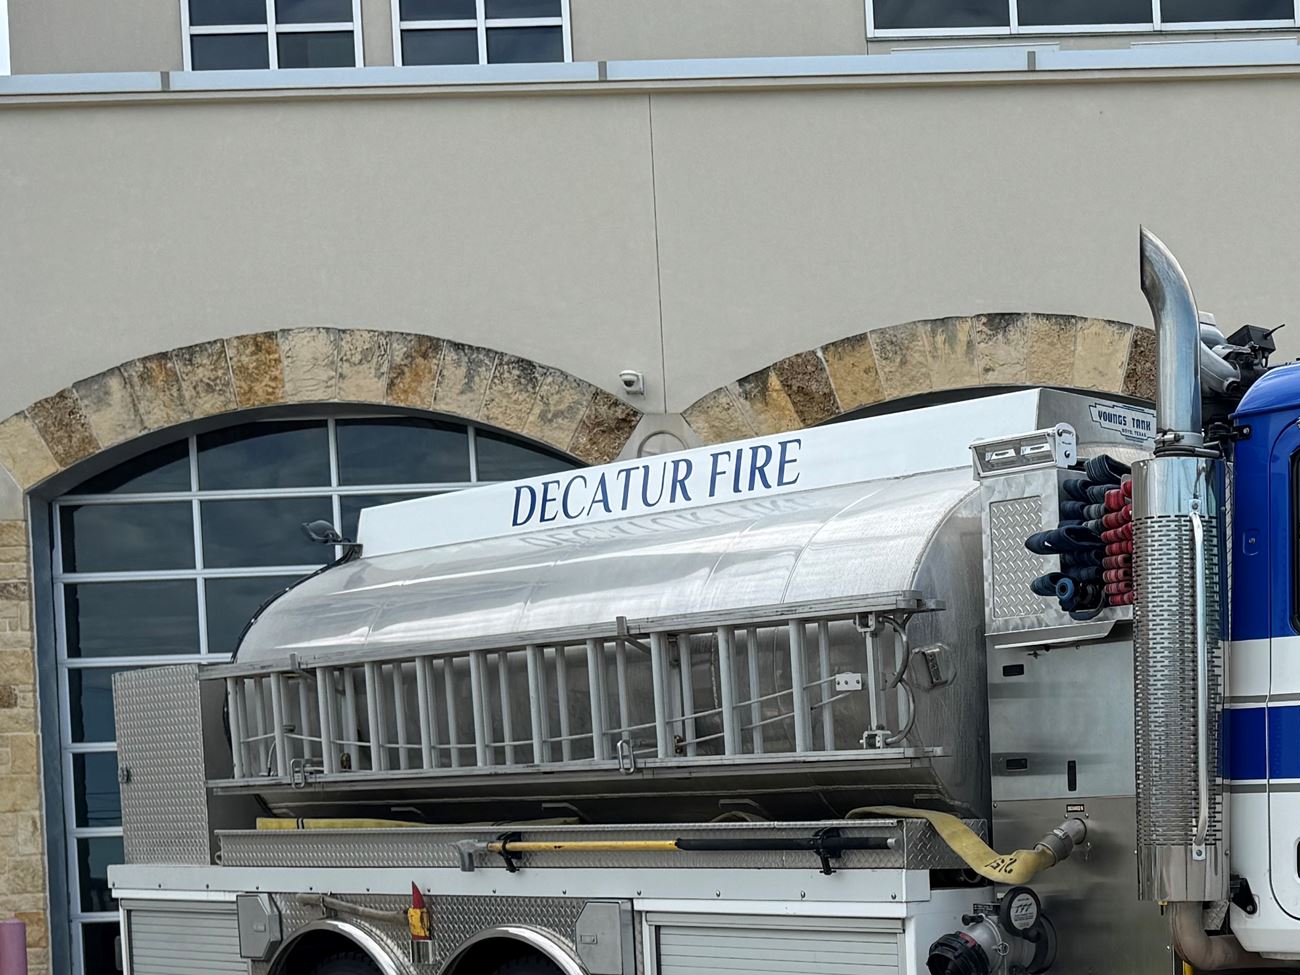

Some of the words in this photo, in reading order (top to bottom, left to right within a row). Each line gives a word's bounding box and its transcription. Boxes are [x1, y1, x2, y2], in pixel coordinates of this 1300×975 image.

[1098, 410, 1127, 426] YOUNGS
[1132, 417, 1151, 431] TANK
[512, 458, 693, 527] DECATUR
[708, 438, 801, 498] FIRE
